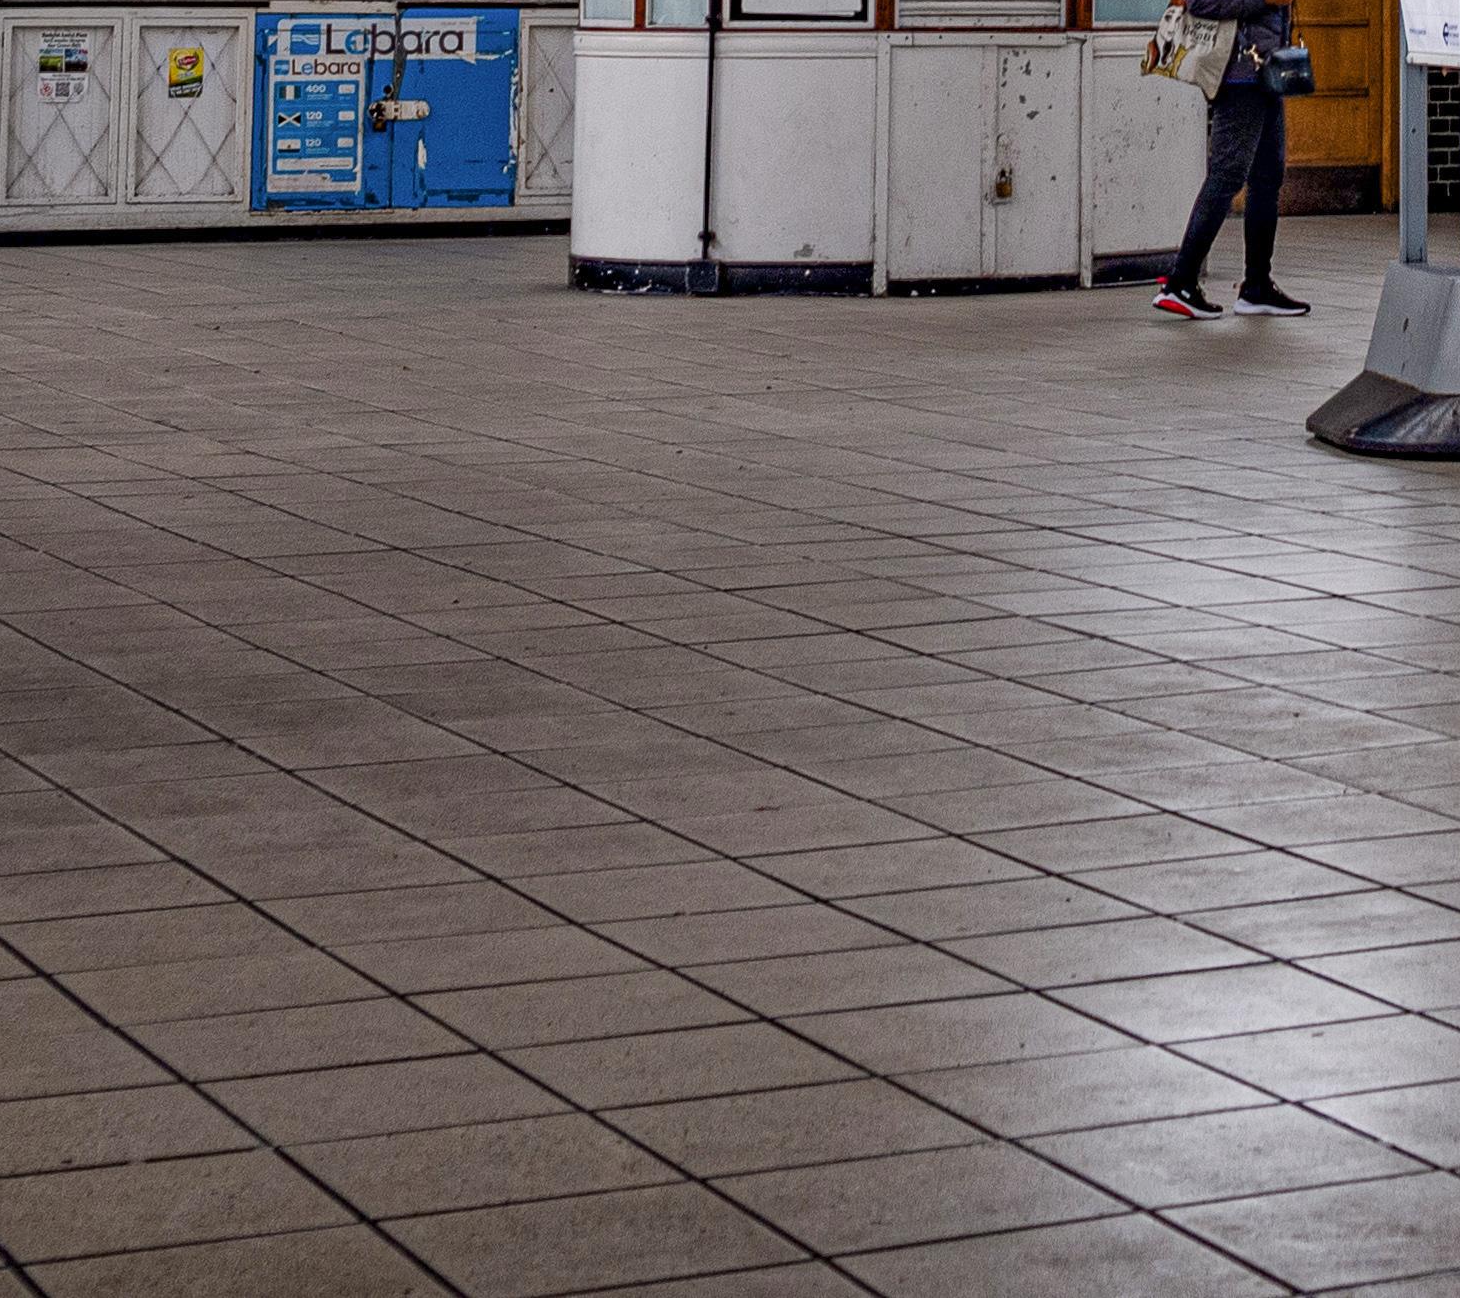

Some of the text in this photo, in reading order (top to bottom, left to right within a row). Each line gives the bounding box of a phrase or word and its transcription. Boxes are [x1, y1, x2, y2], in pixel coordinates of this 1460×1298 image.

[325, 23, 465, 55] Lebara
[292, 59, 361, 76] Lebara
[306, 111, 323, 121] 120
[305, 138, 322, 147] 120
